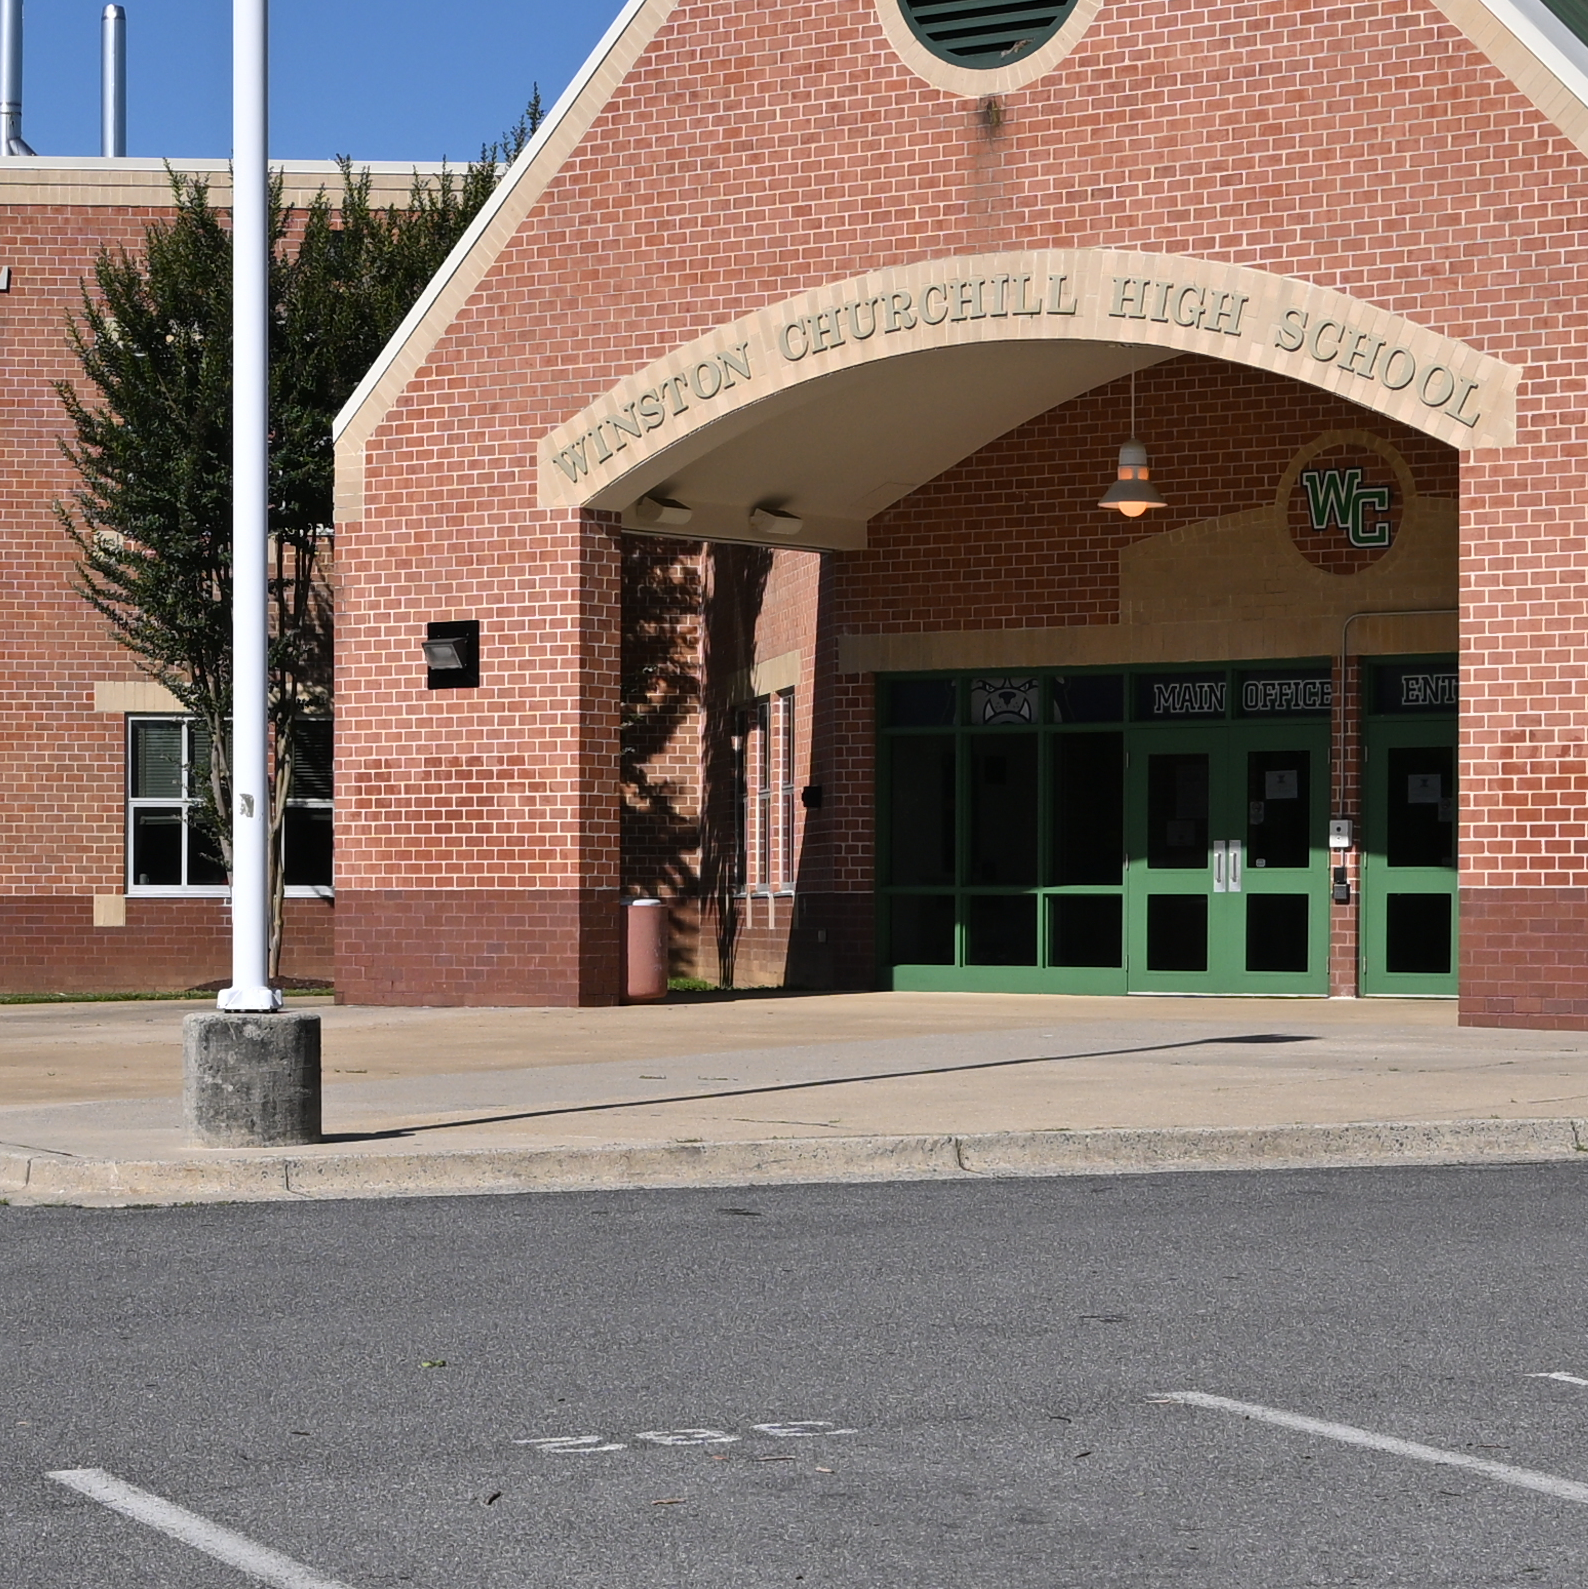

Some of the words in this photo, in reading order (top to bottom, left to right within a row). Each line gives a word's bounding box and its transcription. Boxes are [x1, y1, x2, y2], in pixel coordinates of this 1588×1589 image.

[552, 340, 752, 484] WINSTON
[778, 272, 1078, 362] CHURCHILL
[1108, 276, 1250, 336] HIGH
[1274, 308, 1482, 429] SCHOOL
[1302, 468, 1389, 547] WC
[1154, 681, 1227, 713] MAIN
[1242, 679, 1332, 711] OFFICE
[511, 1420, 859, 1454] 382
